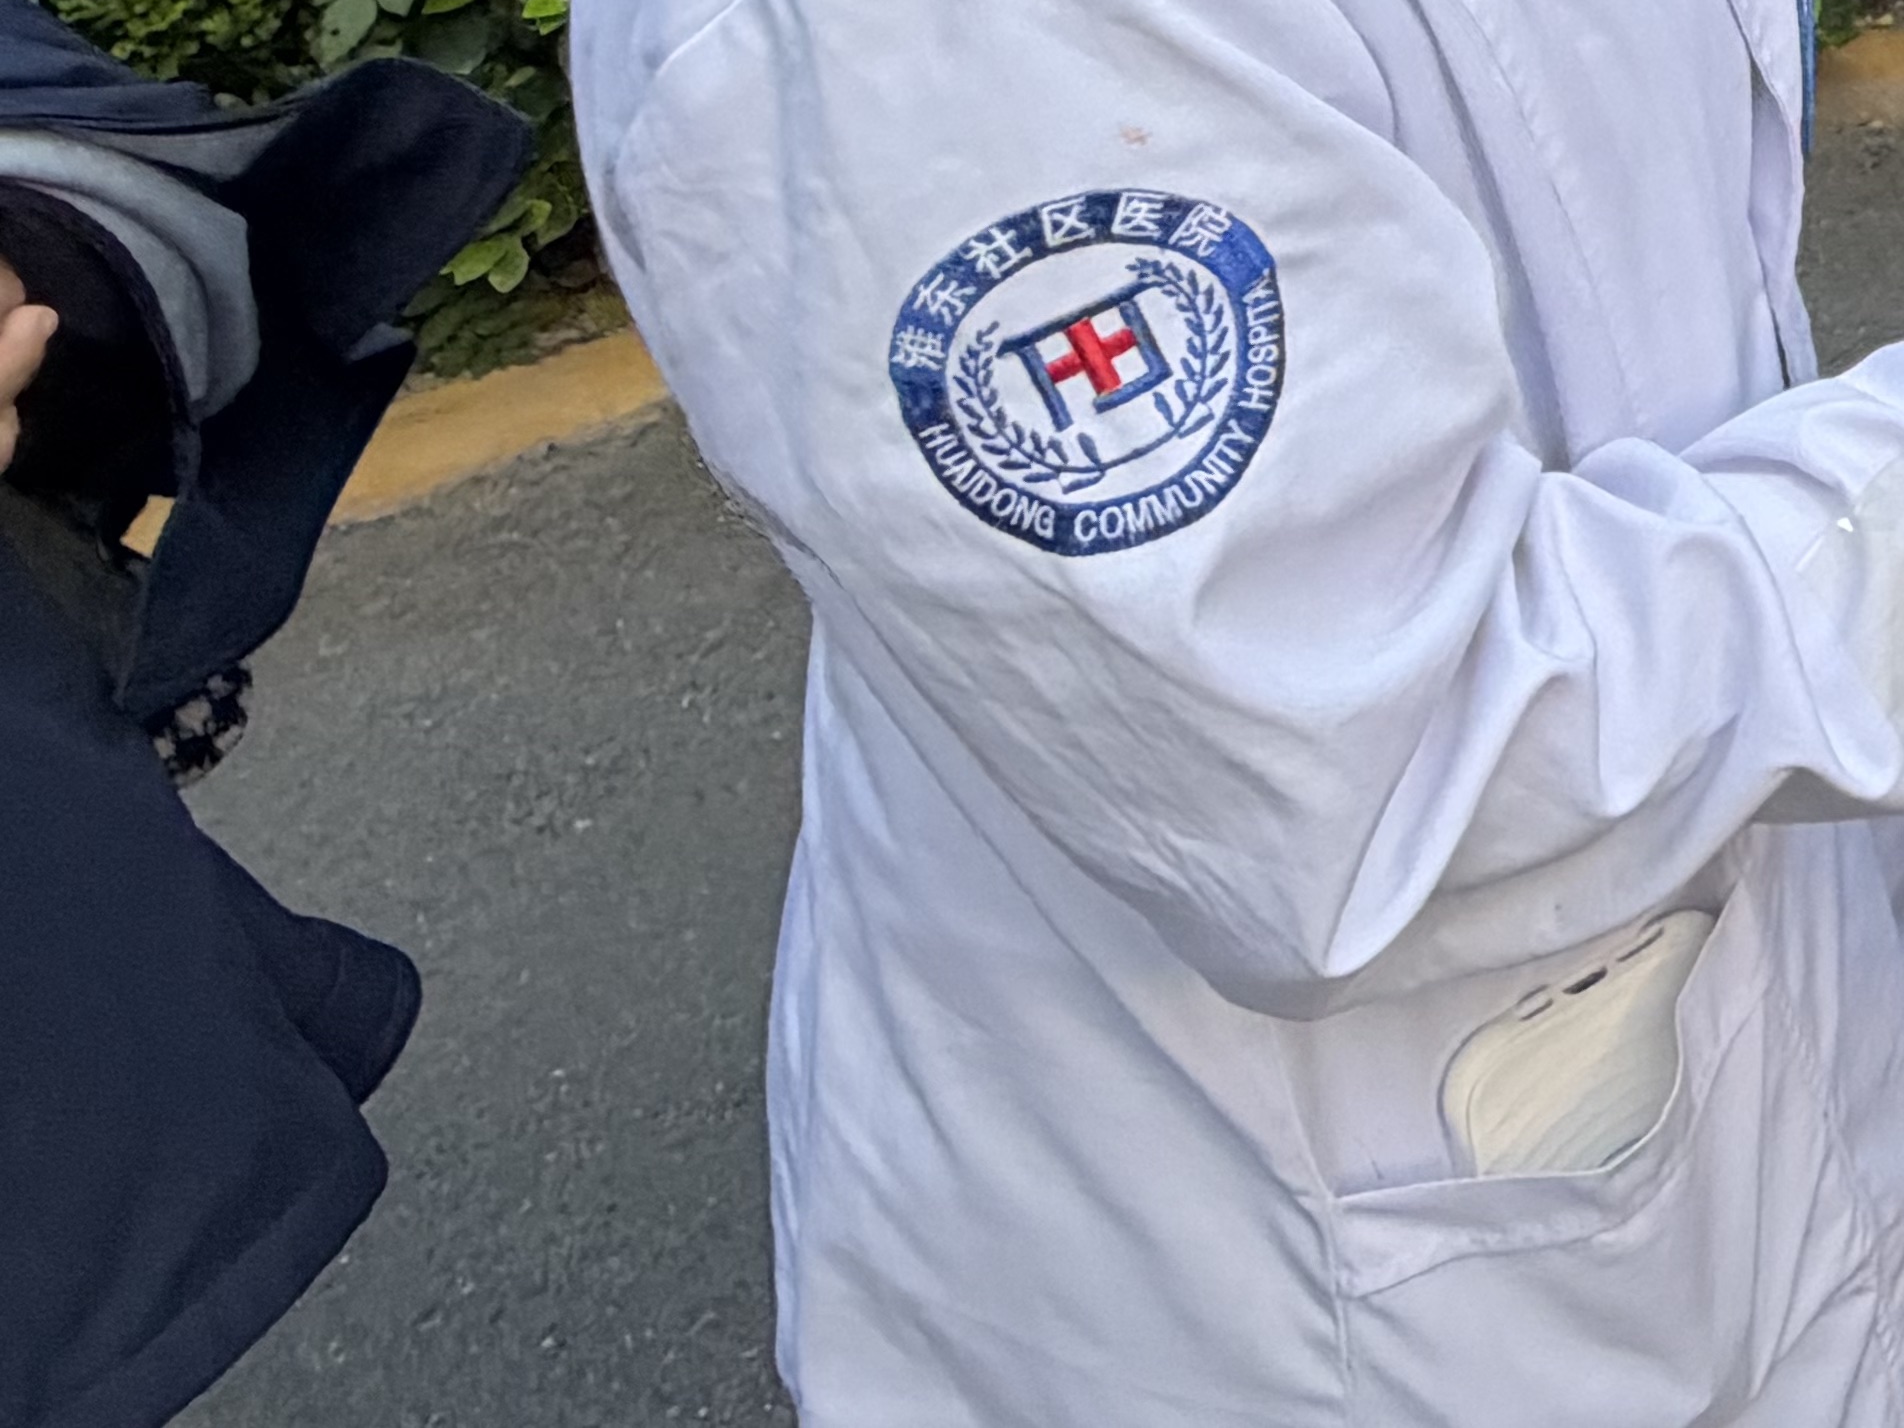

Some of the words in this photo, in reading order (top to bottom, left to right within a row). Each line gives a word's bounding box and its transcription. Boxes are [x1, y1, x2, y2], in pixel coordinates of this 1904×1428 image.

[890, 190, 1232, 371] 淮东社区医院
[918, 422, 1056, 539] HUAIDONG
[1073, 417, 1256, 543] COMMUNITY
